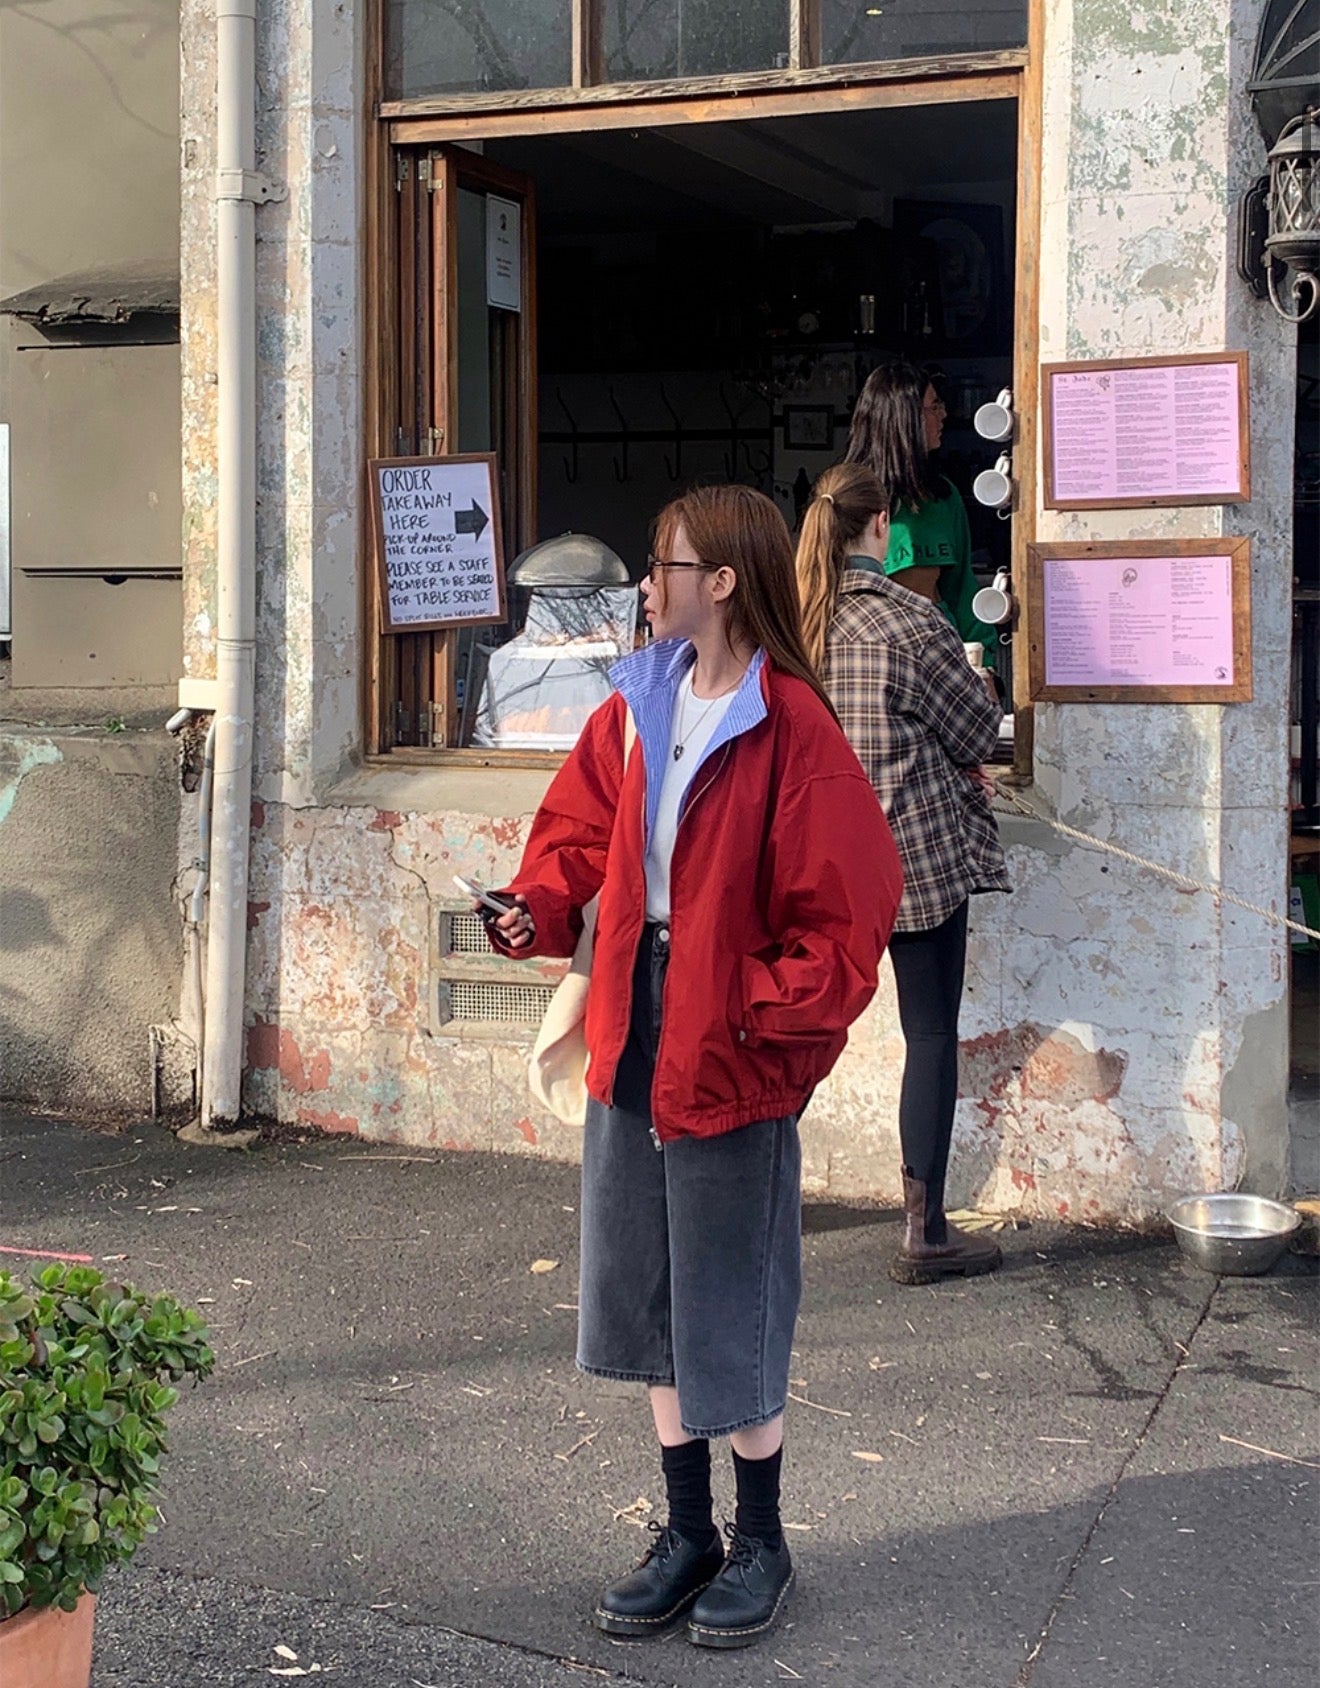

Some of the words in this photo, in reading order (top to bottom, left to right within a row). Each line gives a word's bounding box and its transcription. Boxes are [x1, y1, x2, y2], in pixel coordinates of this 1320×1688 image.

[382, 468, 432, 493] ORDER
[382, 492, 452, 512] TAKEAWAY
[390, 514, 430, 531] HERE
[421, 533, 456, 544] AROUND
[387, 545, 407, 556] THE
[410, 544, 454, 554] CORNER
[387, 561, 423, 578] PLEASE
[425, 560, 445, 573] SEE
[448, 561, 455, 571] A
[458, 557, 490, 572] STAFF
[388, 577, 439, 591] MEMBER
[453, 576, 465, 586] BE
[391, 593, 411, 606] FOR
[414, 590, 452, 606] TABLE
[453, 587, 492, 603] SERVICE
